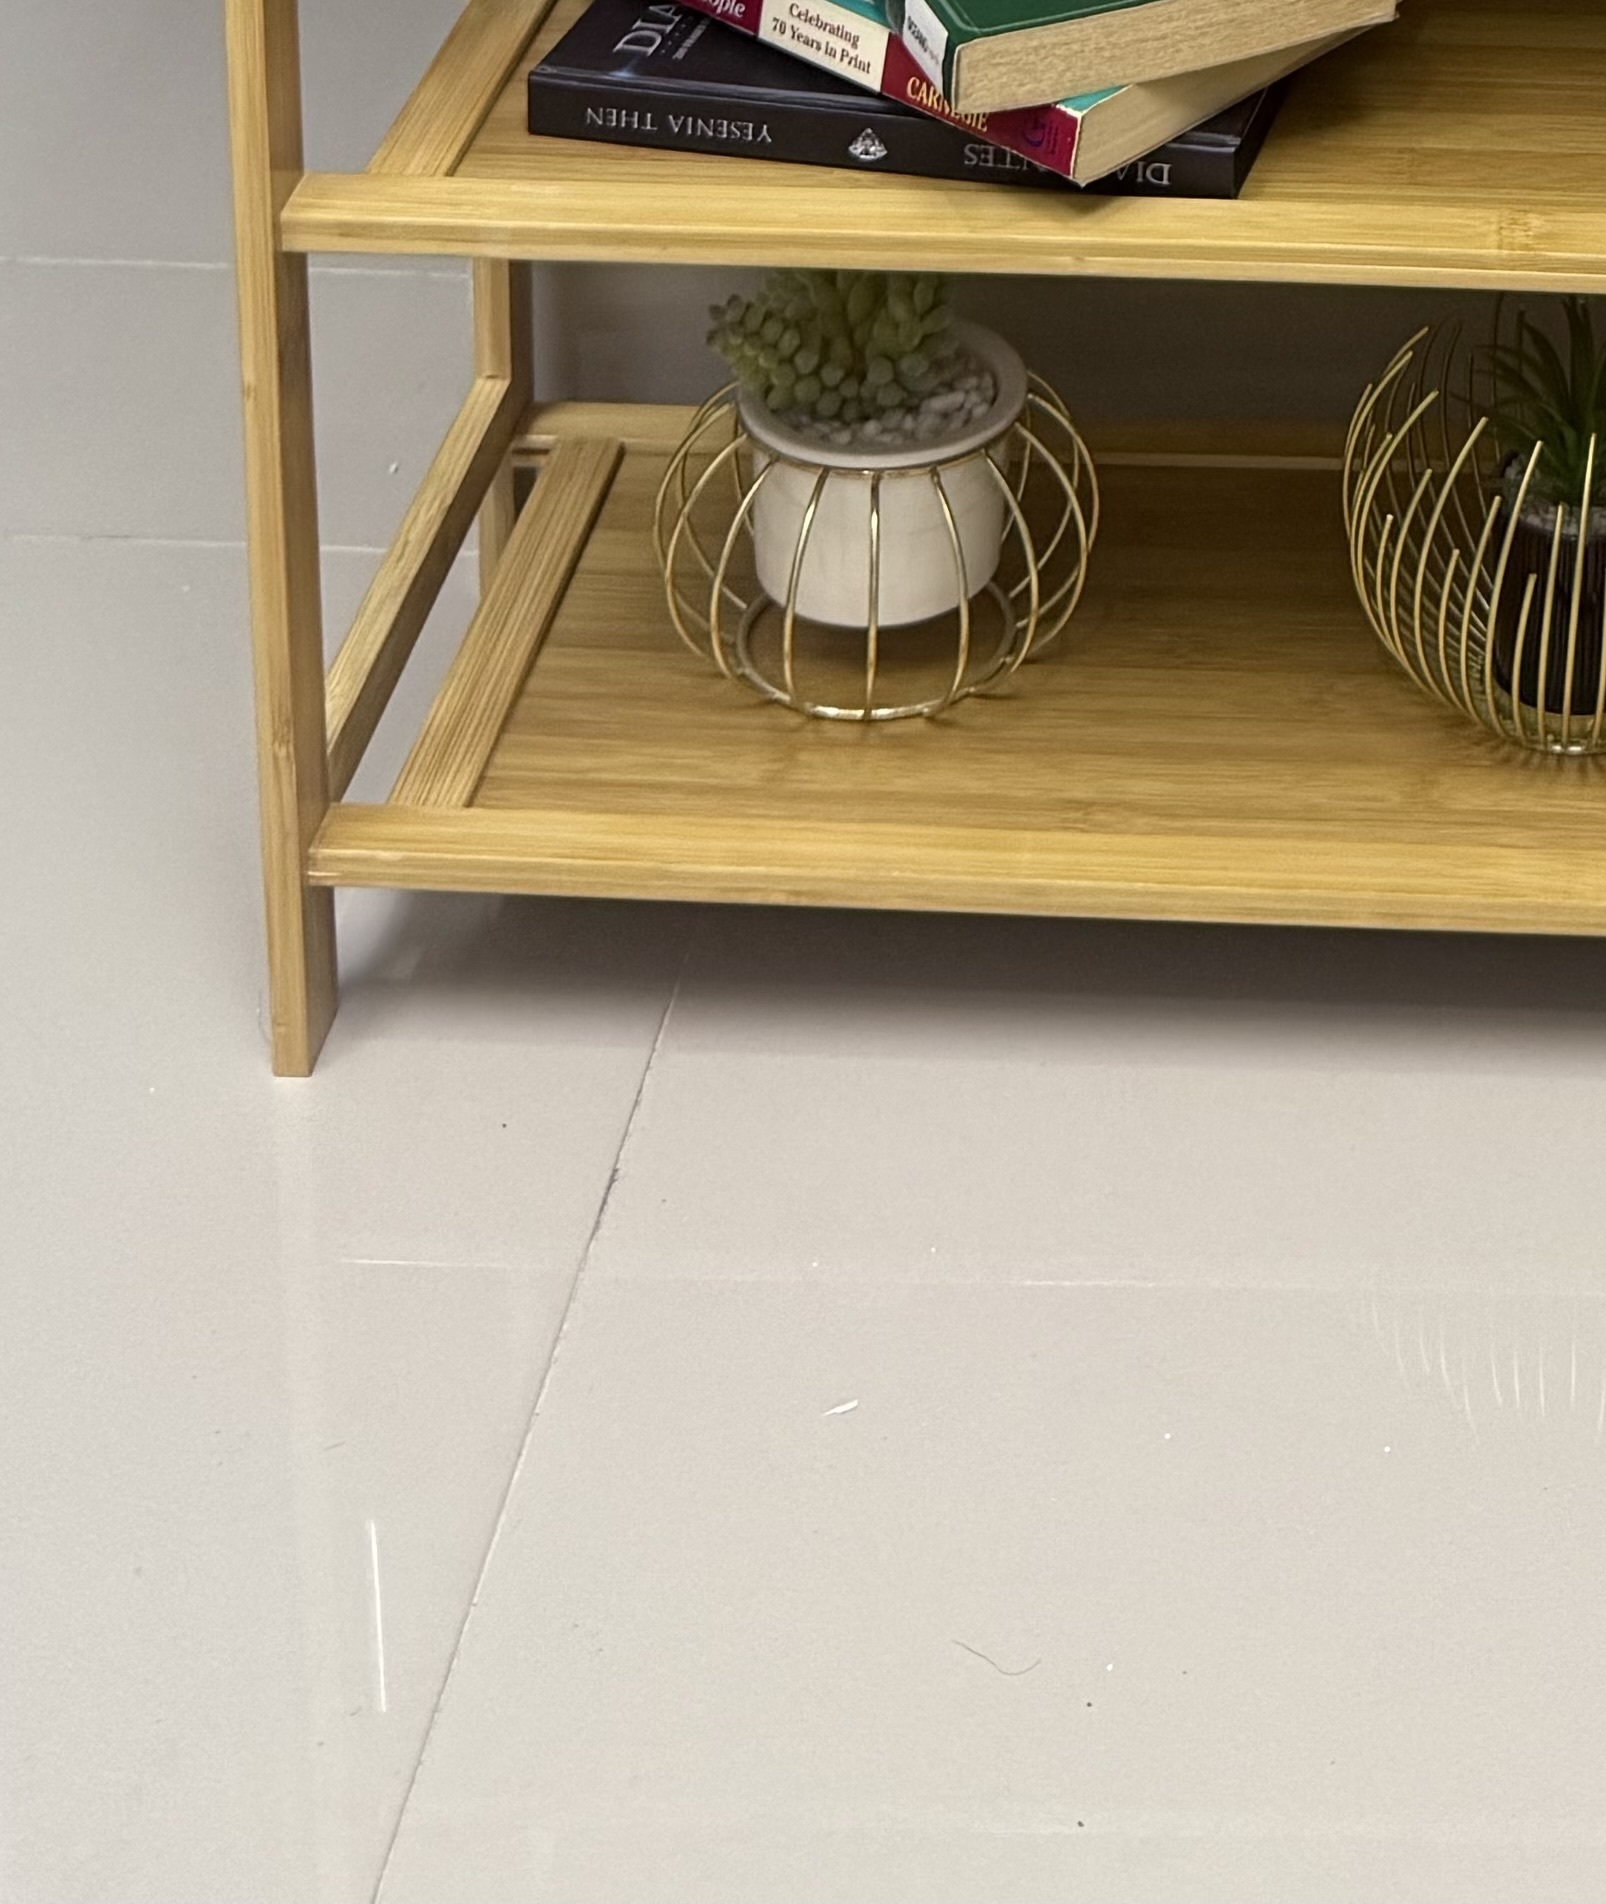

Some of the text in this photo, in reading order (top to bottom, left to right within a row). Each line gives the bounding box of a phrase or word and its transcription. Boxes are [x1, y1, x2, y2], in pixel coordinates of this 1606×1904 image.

[772, 16, 871, 74] 70 Years in Print
[789, 2, 860, 50] Celebrating
[586, 107, 772, 143] YESENIA THEN
